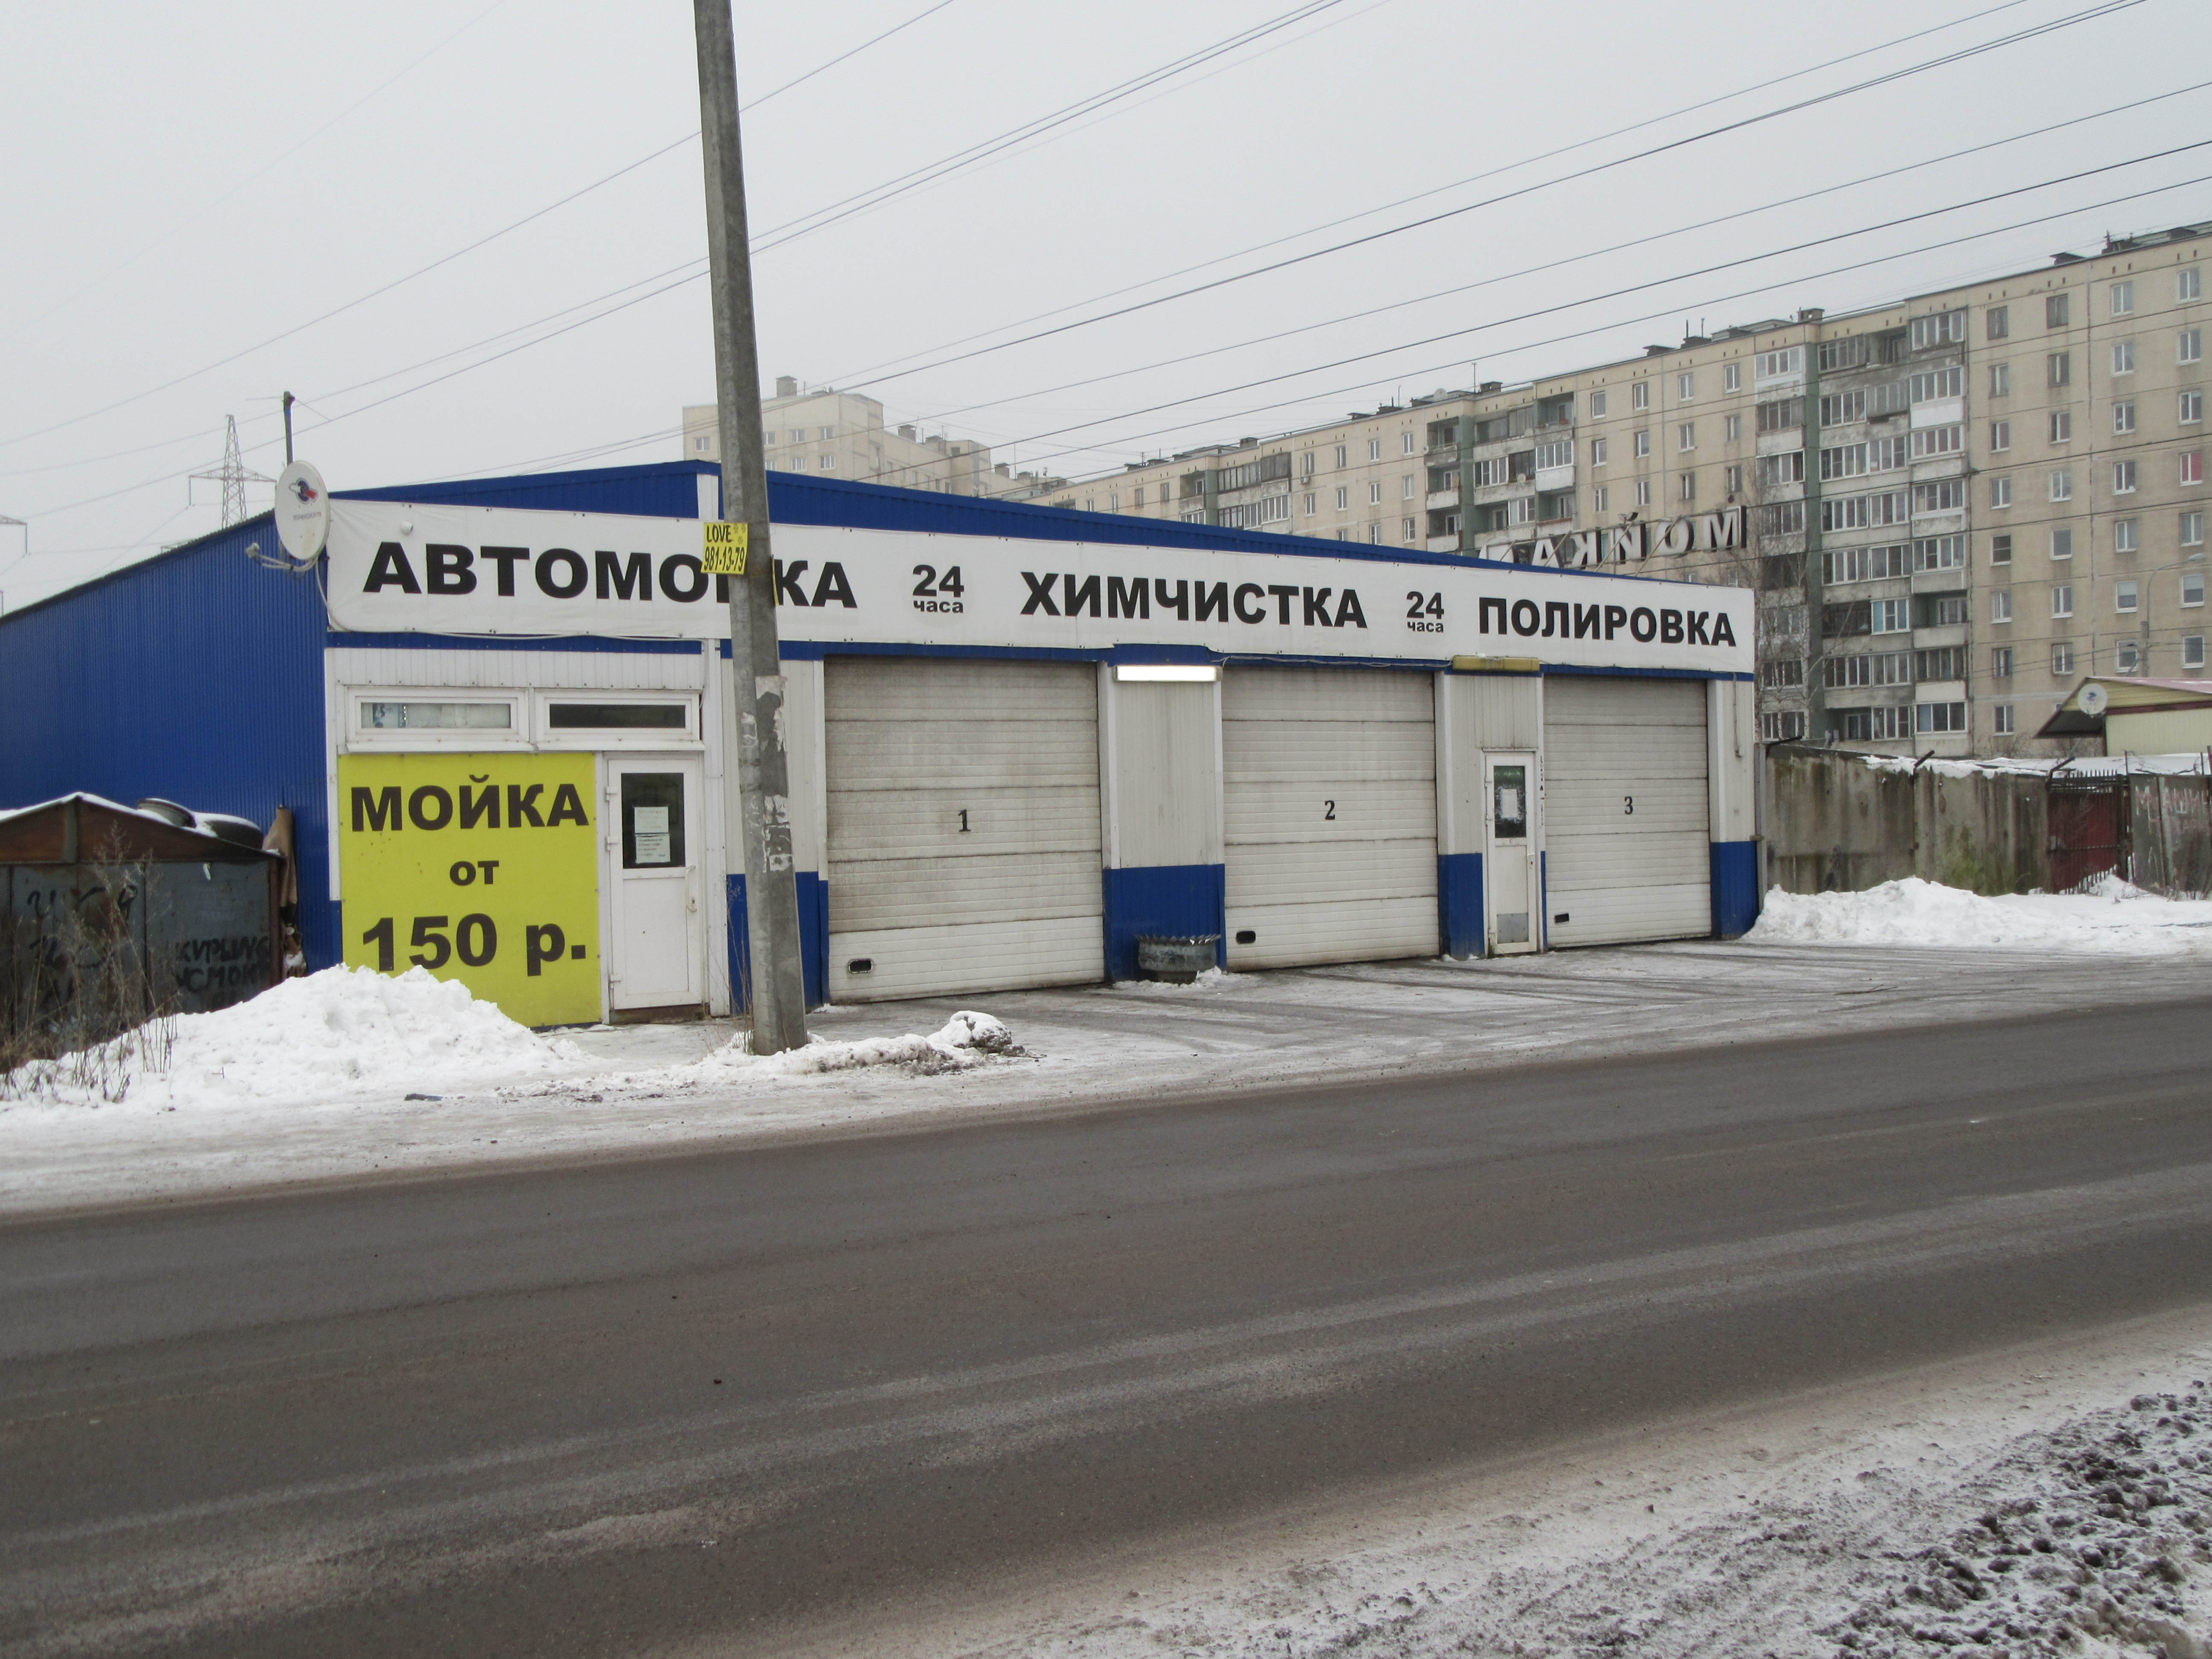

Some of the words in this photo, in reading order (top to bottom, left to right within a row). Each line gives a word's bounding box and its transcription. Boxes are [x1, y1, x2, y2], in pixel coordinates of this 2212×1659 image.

[707, 524, 733, 543] LOVE
[704, 547, 745, 571] 981-13-79
[363, 542, 857, 608] АВТОМОКА
[913, 565, 964, 597] 24
[914, 600, 963, 613] часа
[1021, 572, 1367, 628] ХИМЧИСТКА
[1407, 591, 1444, 620] 24
[1408, 621, 1444, 633] часа
[1479, 597, 1736, 647] ПОЛИРОВКА
[351, 774, 589, 832] МОЙКА
[1324, 800, 1335, 820] 2
[1624, 796, 1633, 815] 3
[958, 809, 971, 832] 1
[449, 860, 499, 886] от
[363, 913, 497, 971] 150
[526, 923, 586, 977] р.
